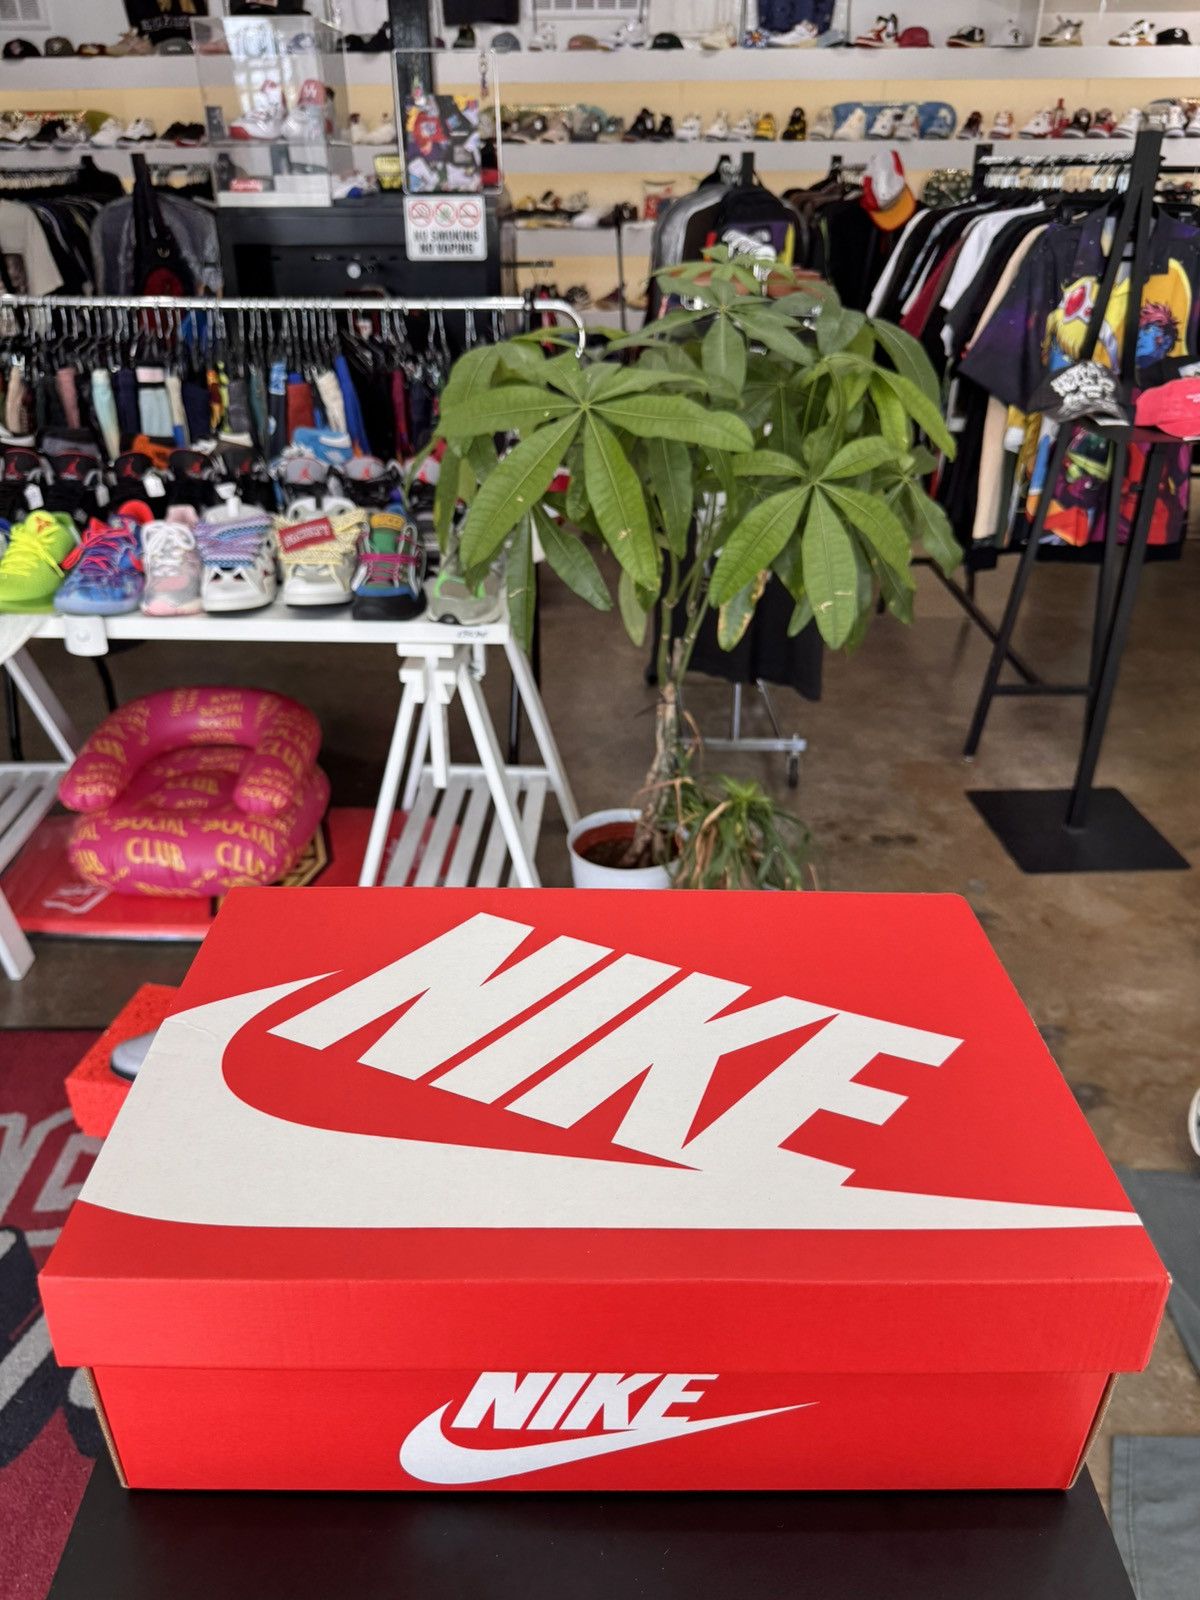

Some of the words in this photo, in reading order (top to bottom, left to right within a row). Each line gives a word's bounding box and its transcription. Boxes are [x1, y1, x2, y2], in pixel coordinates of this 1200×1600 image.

[431, 230, 479, 242] SMOKING
[436, 243, 474, 255] VAPING
[125, 836, 187, 873] CLUB
[266, 912, 965, 1188] NIKE
[451, 1371, 720, 1431] NIKE
